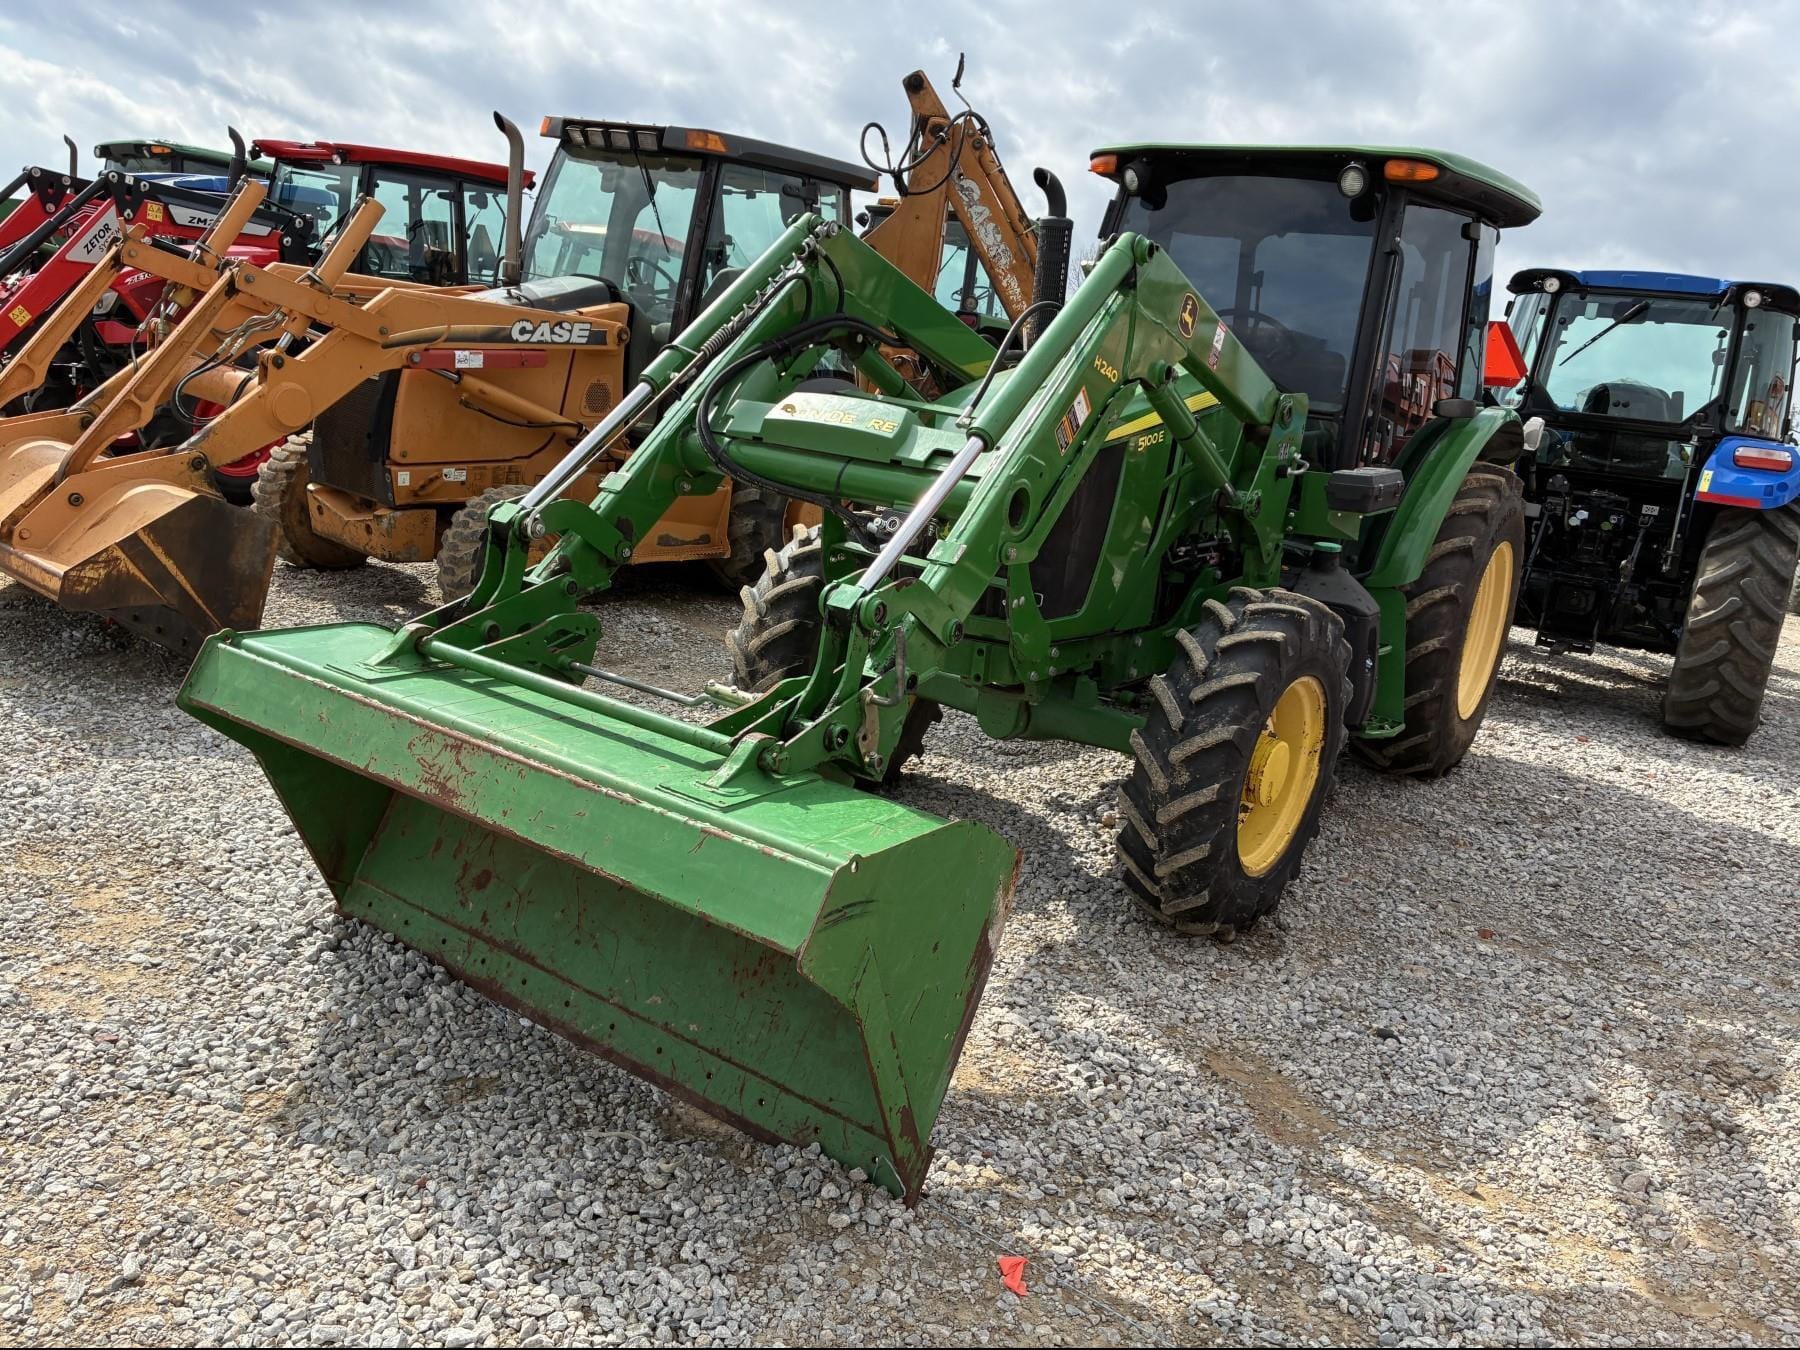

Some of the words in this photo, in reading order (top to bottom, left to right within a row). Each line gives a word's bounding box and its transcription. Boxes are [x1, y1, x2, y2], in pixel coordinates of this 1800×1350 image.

[83, 222, 112, 255] ZETOR
[511, 320, 591, 344] CASE
[1093, 355, 1118, 384] H240
